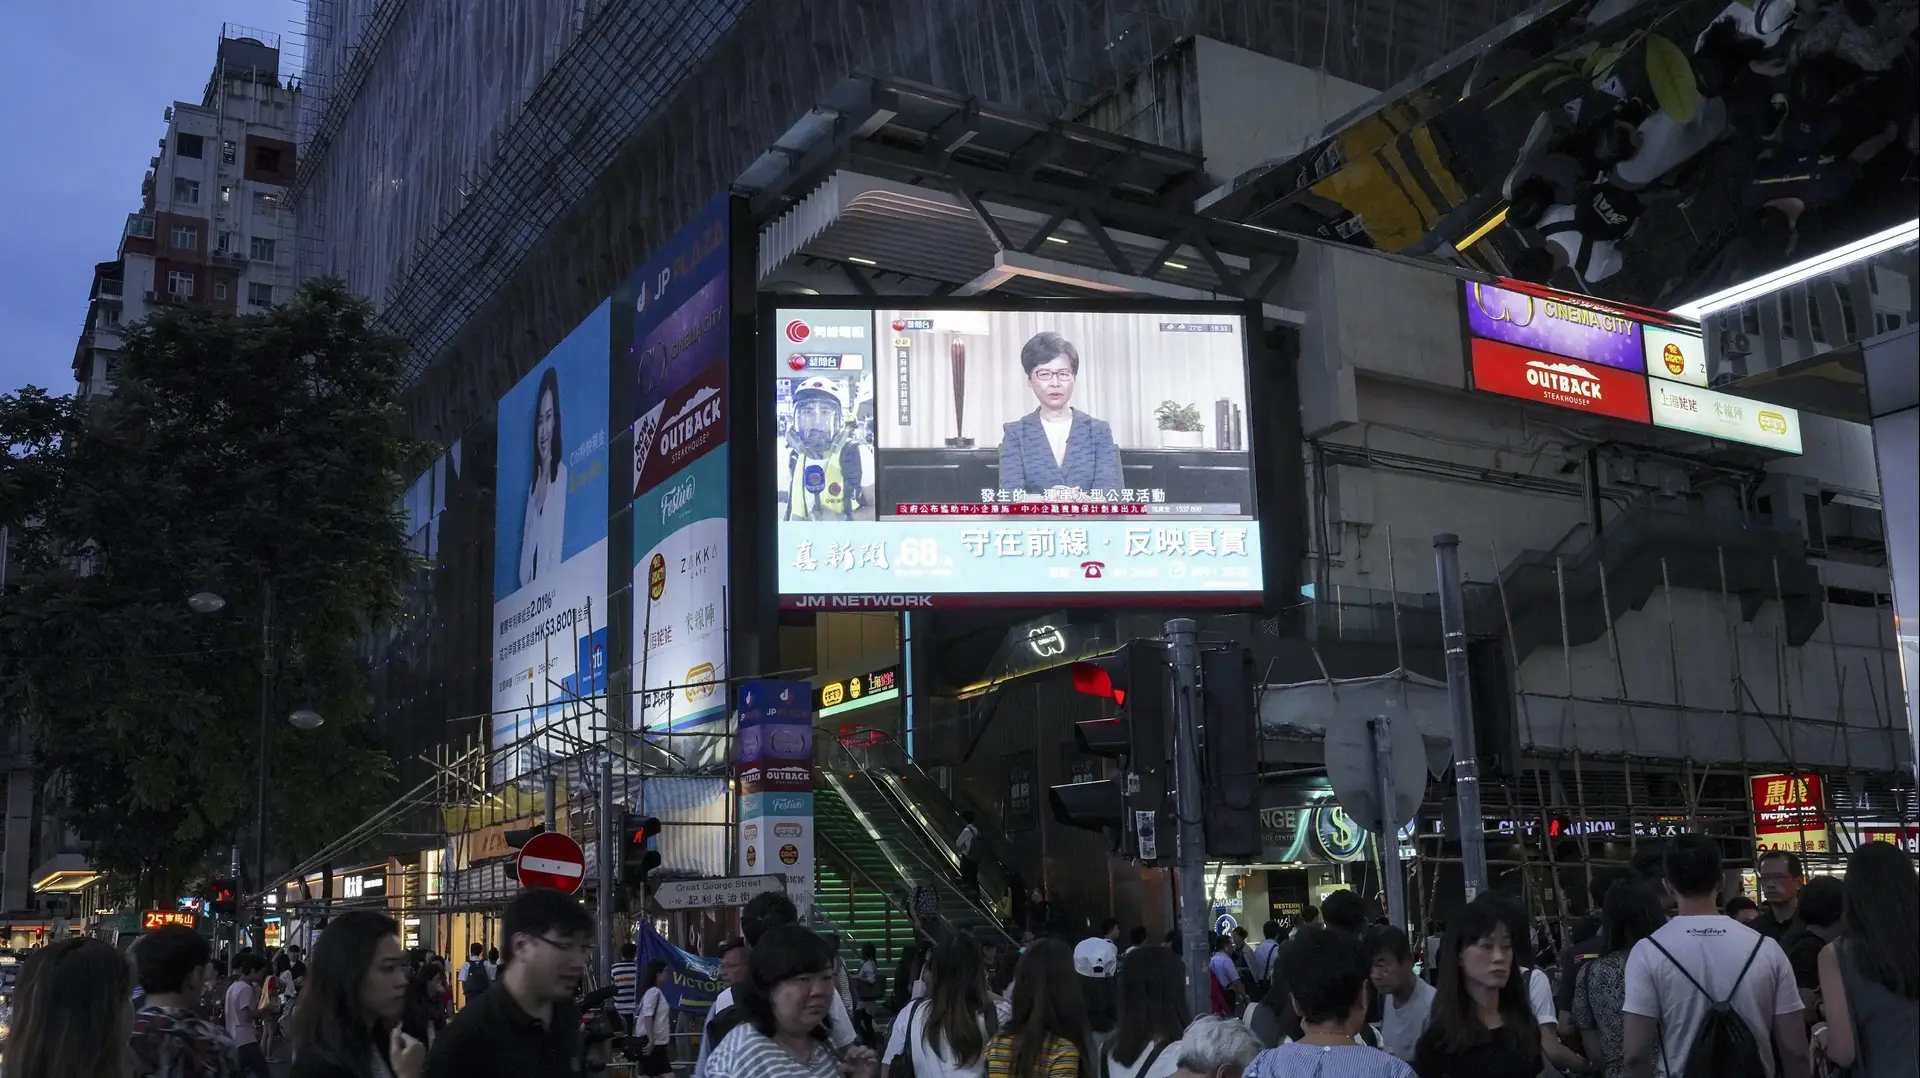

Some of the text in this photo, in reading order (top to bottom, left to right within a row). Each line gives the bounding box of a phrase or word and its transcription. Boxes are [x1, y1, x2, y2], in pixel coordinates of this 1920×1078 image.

[654, 268, 670, 300] JP
[1544, 301, 1600, 329] CINEMA
[1602, 316, 1633, 336] CITY
[671, 304, 723, 359] CINEMA CITY
[809, 356, 836, 367] 新聞台
[1526, 368, 1602, 400] OUTBACK
[635, 415, 649, 456] NOW
[660, 396, 721, 456] OUTBACK
[672, 433, 706, 464] STEAKHOUSE
[981, 488, 1165, 503] 發生的一連串大型公眾活動
[681, 544, 718, 574] ZAKKA
[796, 595, 933, 606] JM NETWORK
[740, 773, 761, 783] OUTBACK
[766, 772, 810, 780] OUTBACK
[1764, 778, 1809, 806] 惠康
[1562, 821, 1615, 835] ANSION
[676, 880, 761, 892] Great George Street
[688, 892, 750, 905] 記利佐治街
[146, 913, 163, 927] 25
